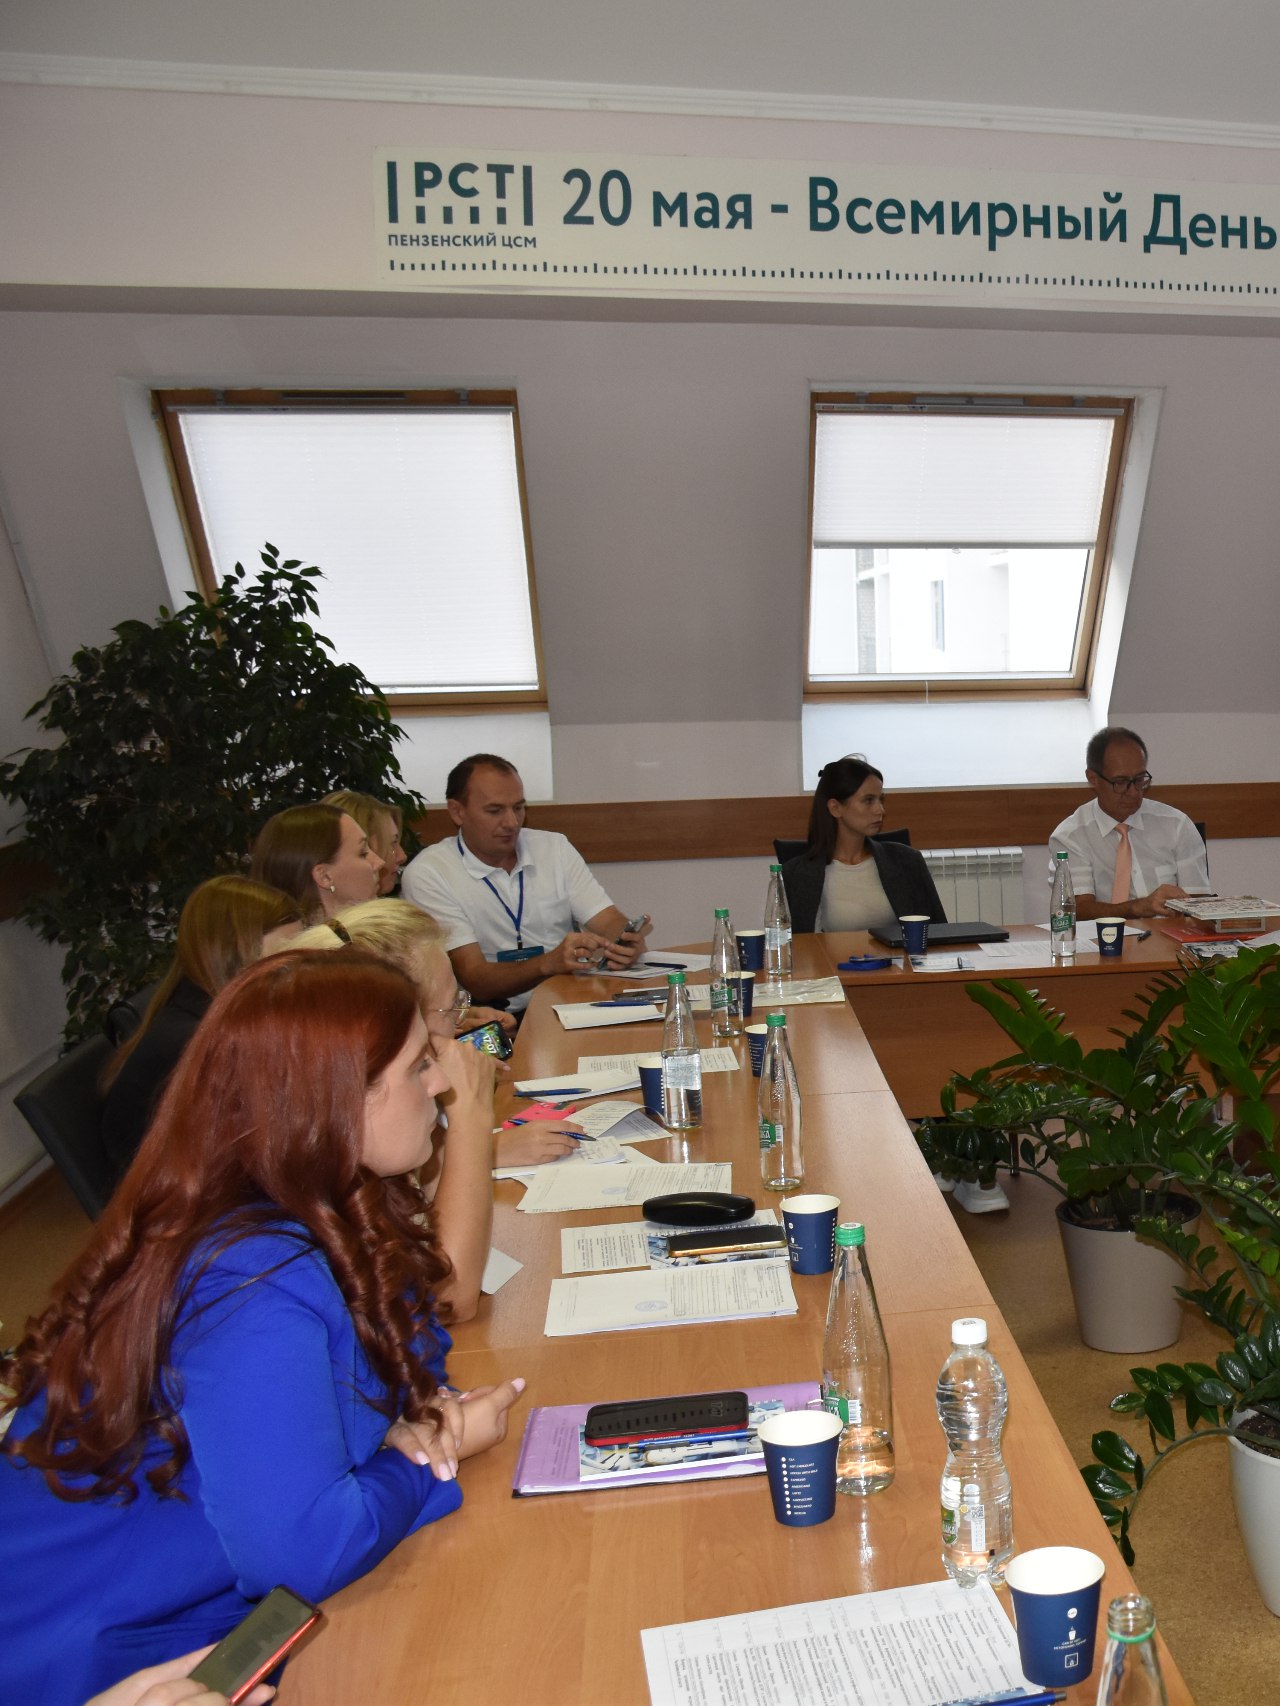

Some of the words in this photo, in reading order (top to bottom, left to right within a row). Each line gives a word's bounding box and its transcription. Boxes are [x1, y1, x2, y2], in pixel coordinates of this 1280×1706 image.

[562, 168, 632, 227] 20
[652, 190, 753, 230] мая
[808, 176, 1127, 252] Всемирный
[1143, 193, 1278, 256] День
[388, 232, 497, 247] ПЕНЗЕНСКИЙ
[501, 235, 538, 249] ЦСМ
